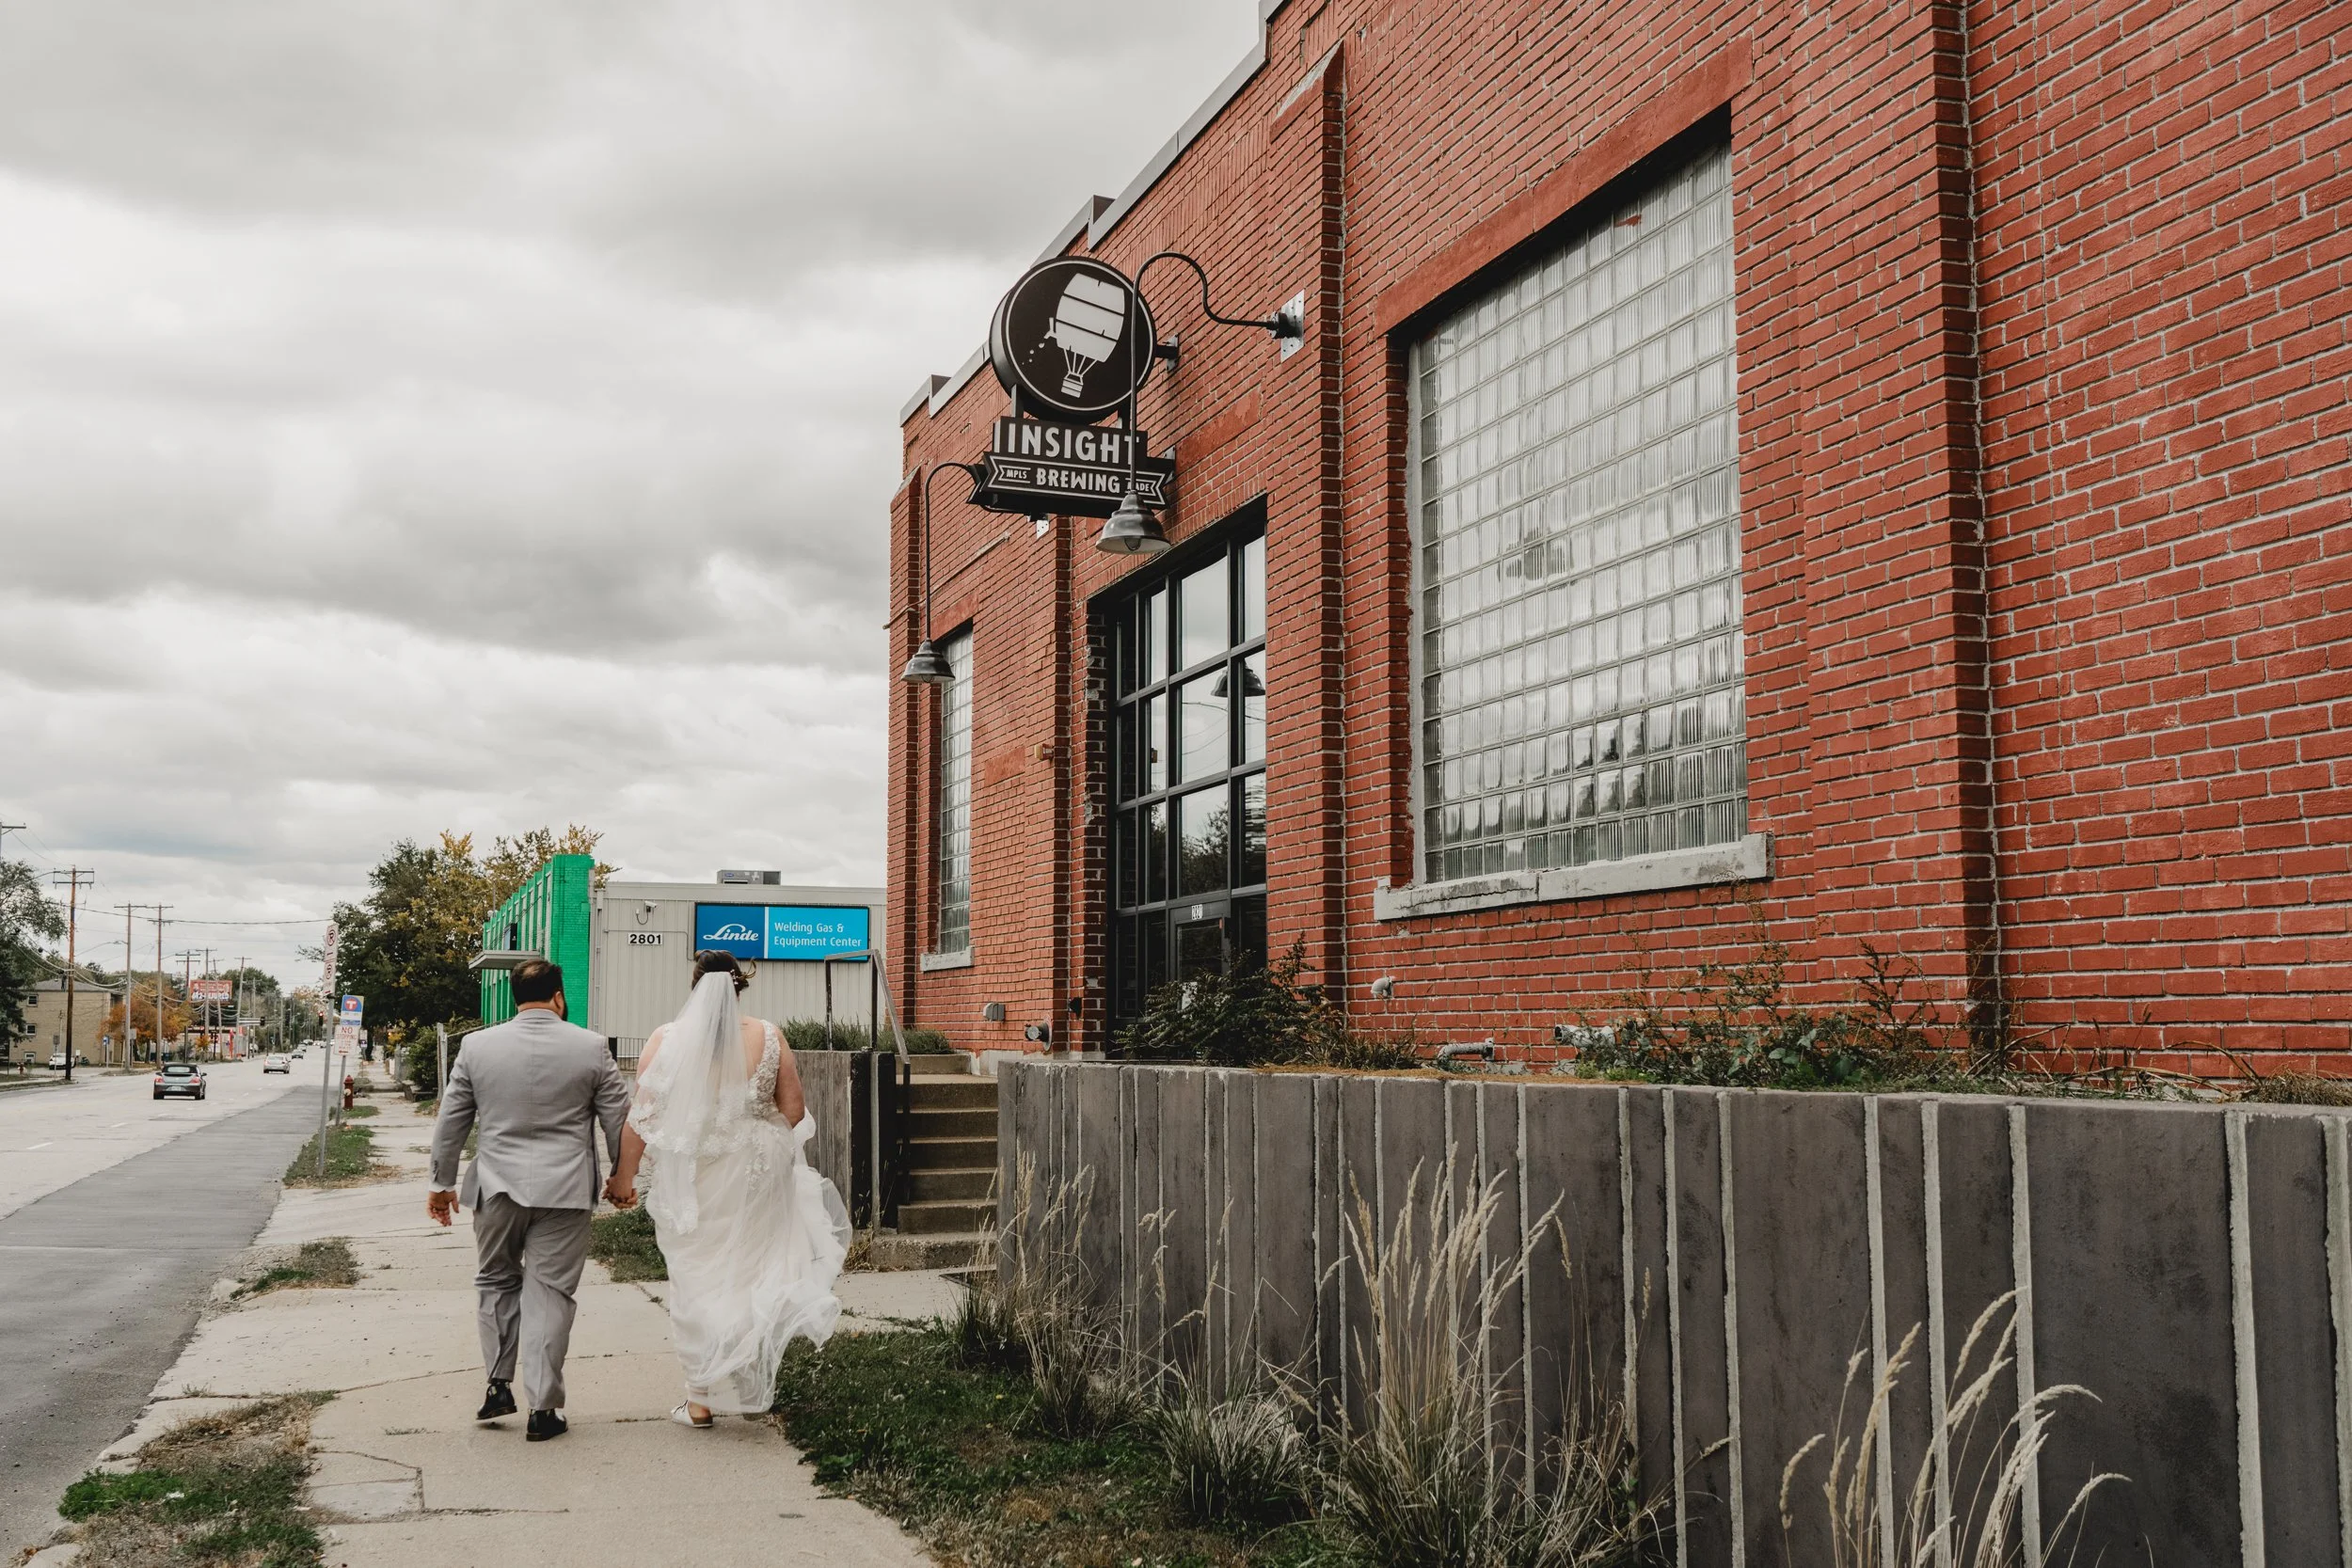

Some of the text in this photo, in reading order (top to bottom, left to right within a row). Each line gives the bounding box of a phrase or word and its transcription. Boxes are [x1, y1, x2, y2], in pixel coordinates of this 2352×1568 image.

[1008, 423, 1139, 465] INSIGHT
[1006, 469, 1027, 479] MPLS
[1036, 467, 1120, 493] BREWING
[703, 923, 758, 942] Linde
[774, 922, 844, 935] Welding Gas &
[629, 933, 661, 944] 2801
[774, 935, 862, 947] Equipment Center
